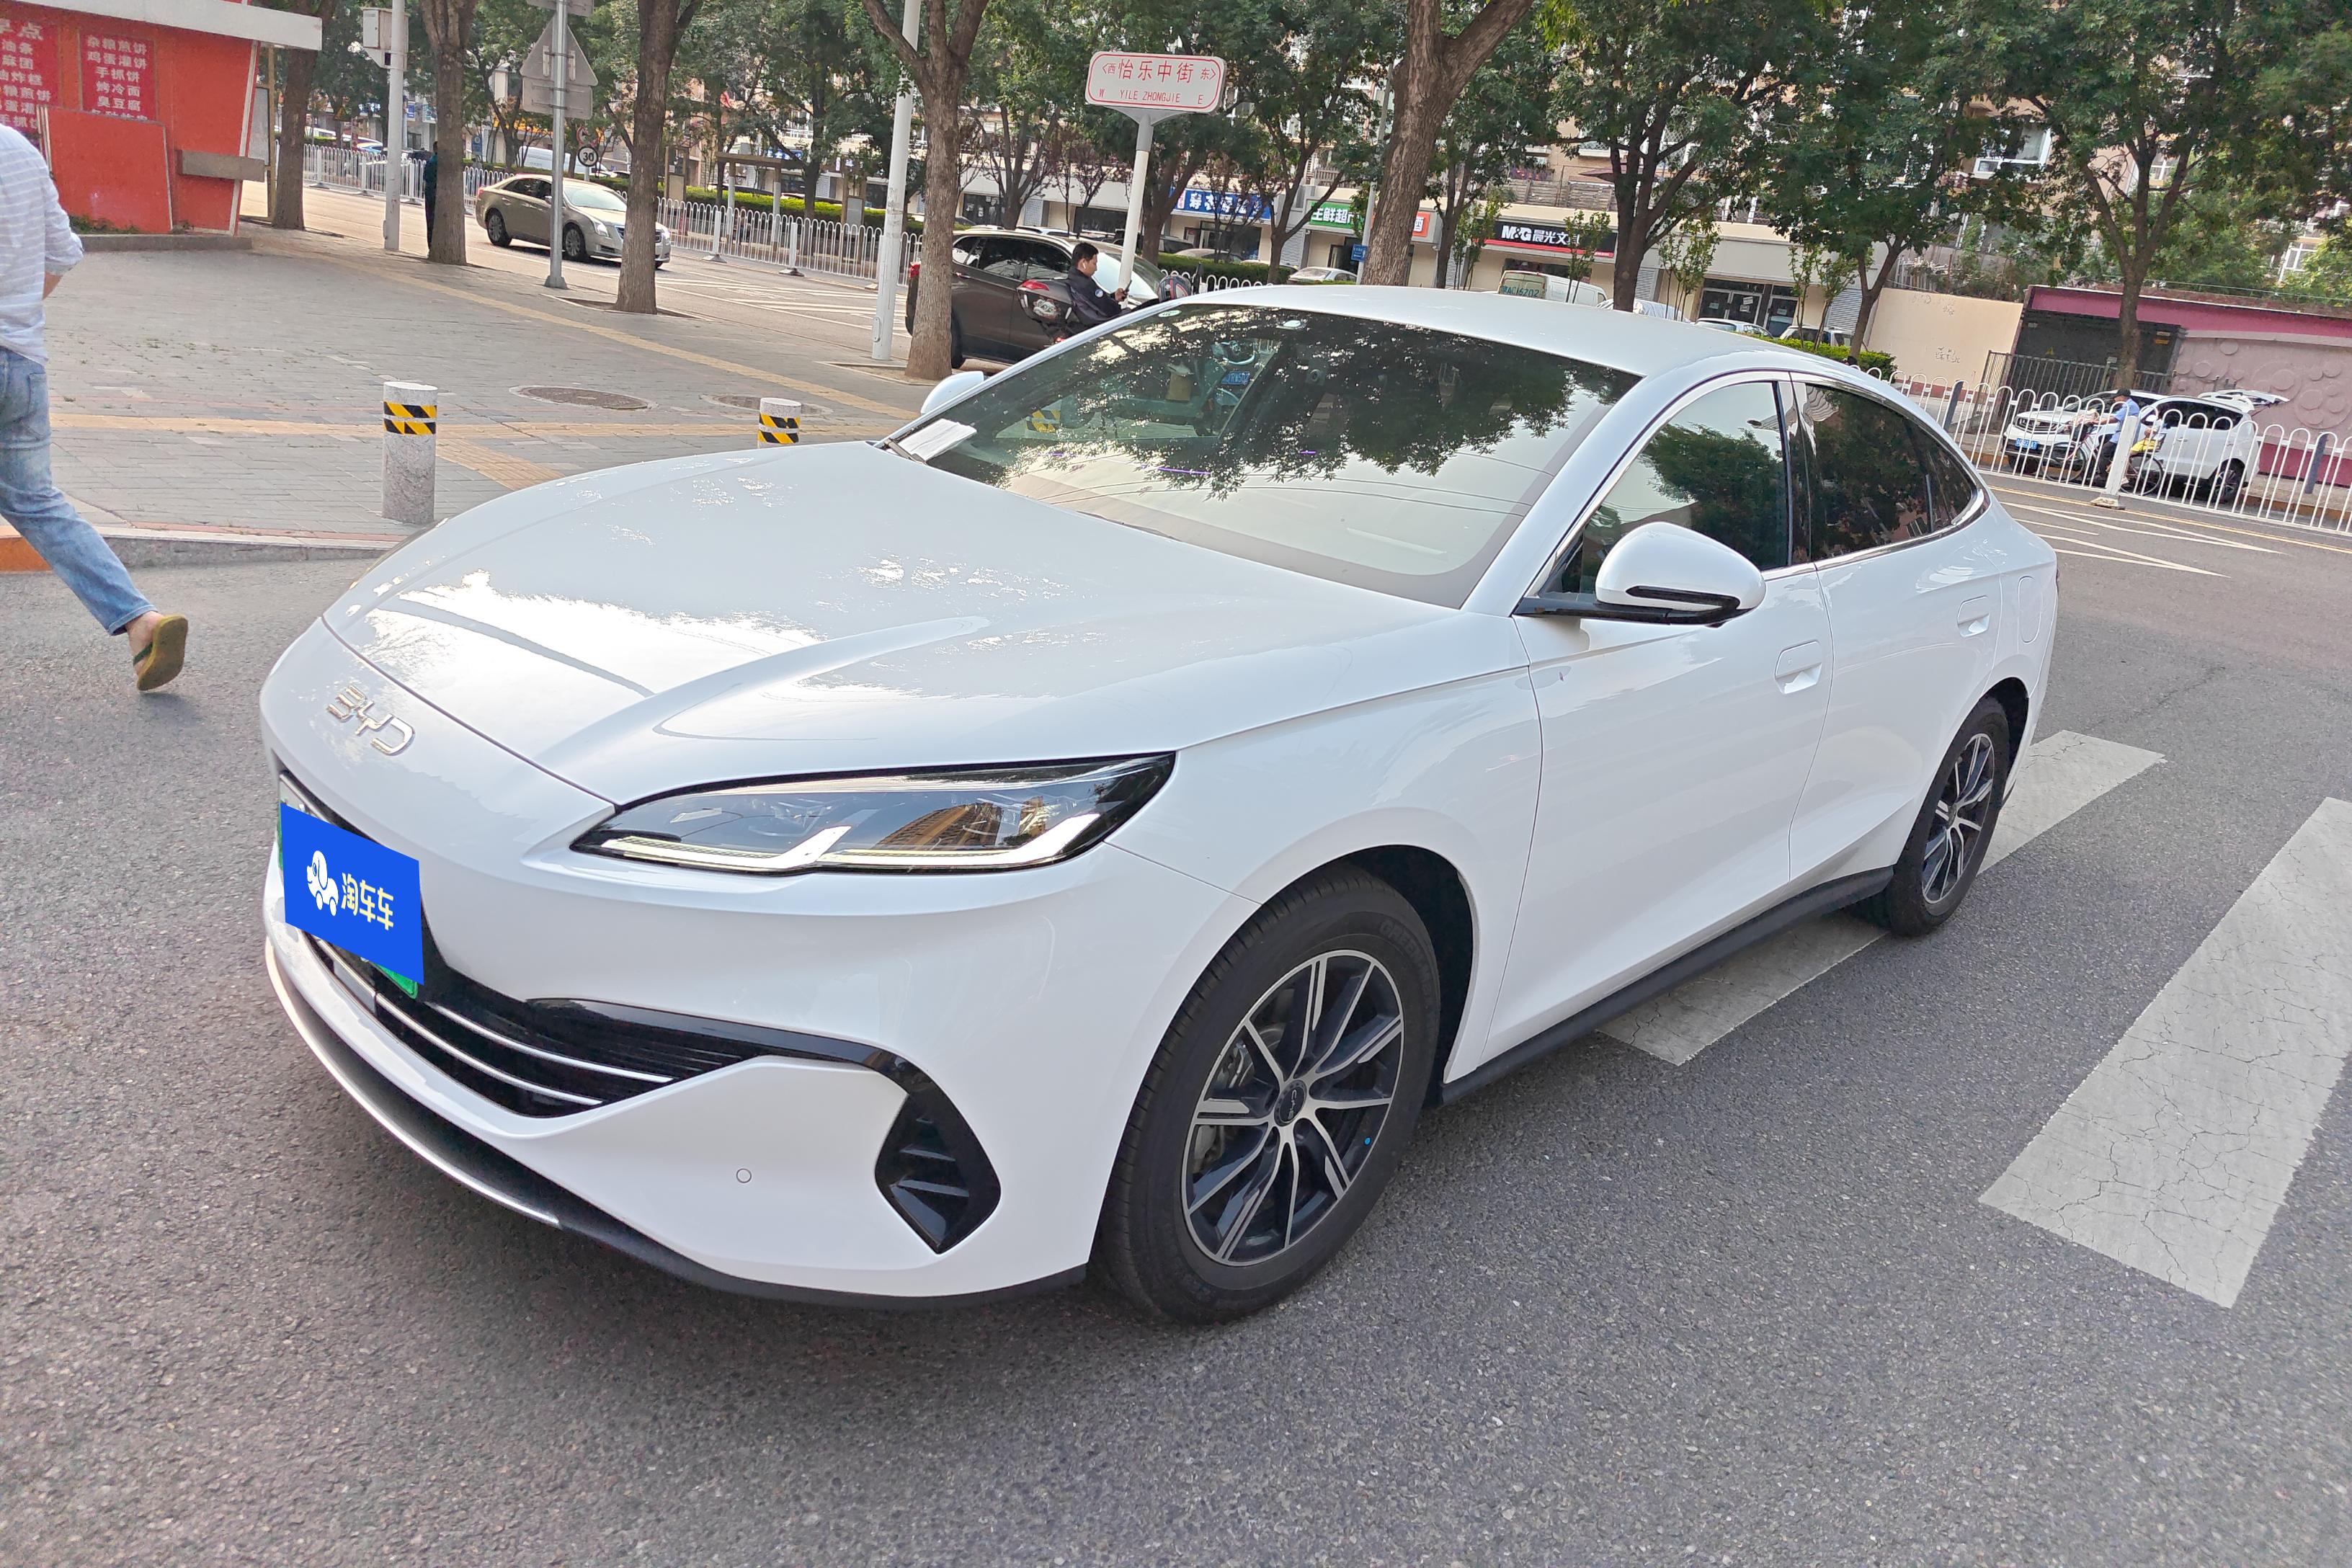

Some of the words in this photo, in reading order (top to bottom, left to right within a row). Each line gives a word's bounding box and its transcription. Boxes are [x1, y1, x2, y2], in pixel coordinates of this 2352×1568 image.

[87, 51, 148, 70] 鸡蛋灌饼
[95, 66, 141, 83] 手抓饼
[1108, 63, 1116, 74] 西
[1118, 58, 1194, 84] 怡乐中街
[1200, 68, 1210, 80] 东
[0, 84, 51, 102] 粮煎饼
[96, 81, 141, 97] 烤冷面
[1099, 88, 1105, 98] W
[1120, 89, 1139, 100] YILE
[1142, 91, 1180, 103] ZHONGJIE
[1198, 94, 1204, 104] E
[0, 99, 35, 115] 蛋灌
[97, 96, 141, 112] 臭豆腐
[582, 152, 594, 162] 30
[1501, 225, 1532, 241] M&G
[326, 685, 416, 756] BYD
